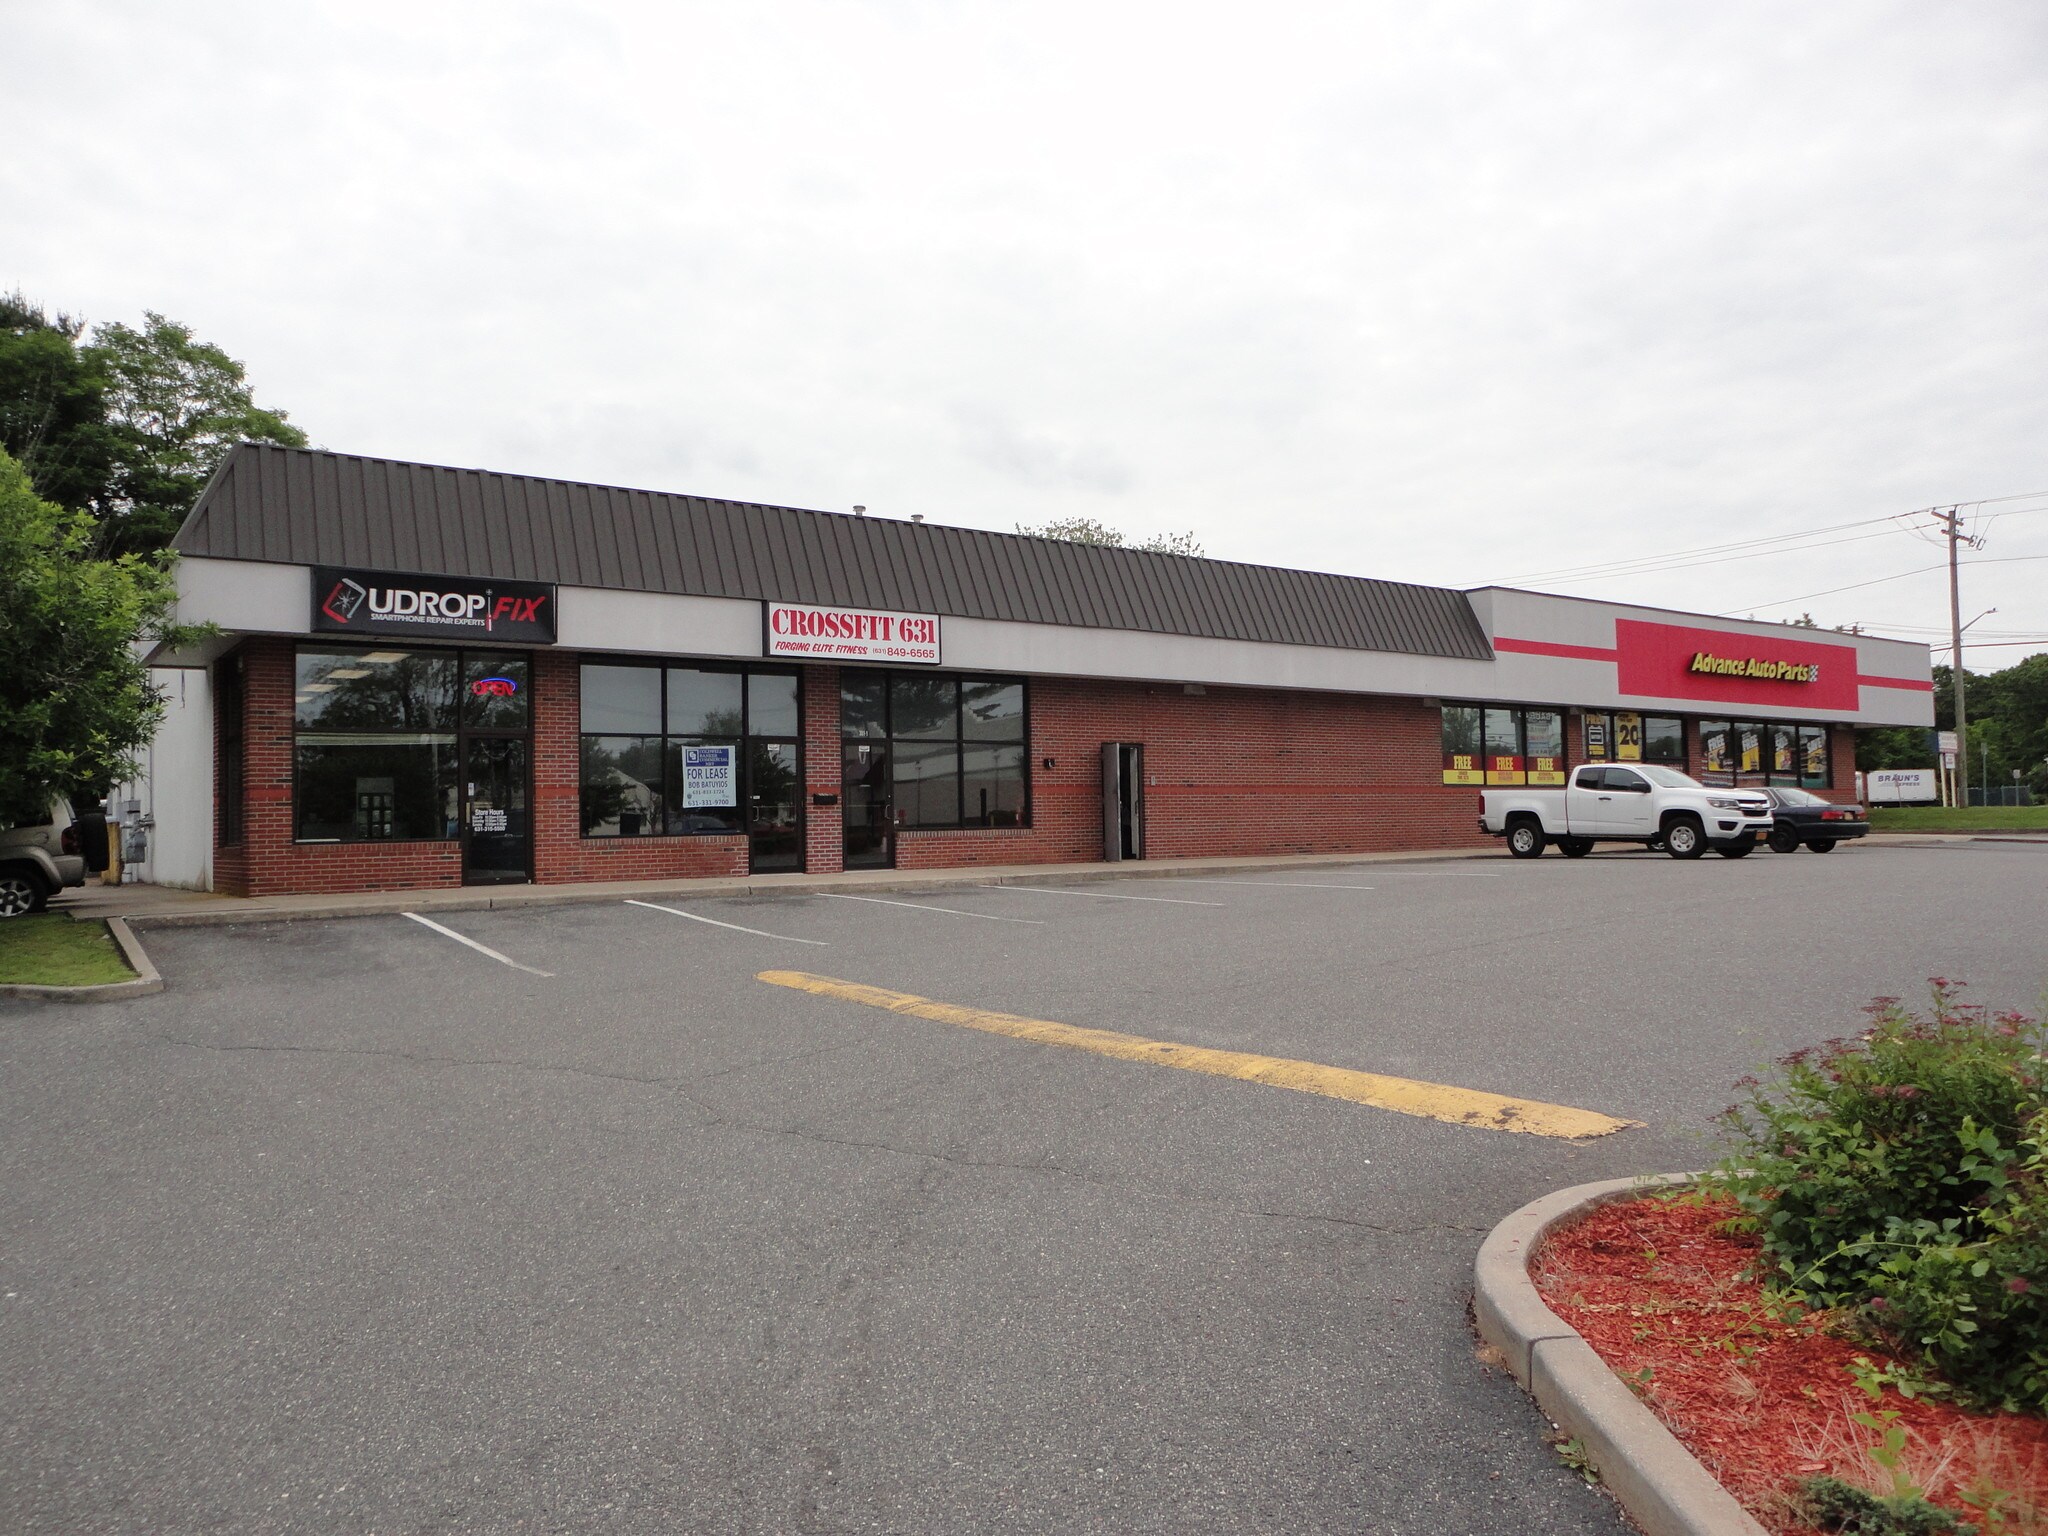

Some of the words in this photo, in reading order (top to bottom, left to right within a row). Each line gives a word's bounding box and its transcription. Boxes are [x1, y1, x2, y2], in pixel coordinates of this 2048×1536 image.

[491, 595, 546, 623] FIX
[370, 613, 426, 624] SMARTPHONE
[426, 615, 454, 625] REPAIR
[454, 617, 486, 627] EXPERTS
[772, 609, 894, 641] CROSSFIT
[899, 617, 936, 644] 631
[775, 641, 811, 652] FORGING
[812, 643, 835, 653] ELITE
[835, 644, 868, 655] FITNESS
[1691, 652, 1745, 676] Advance
[1745, 657, 1777, 679] Auto
[1777, 660, 1809, 682] Parts
[471, 680, 514, 697] OPEN
[1453, 755, 1472, 769] FREE
[1496, 756, 1513, 771] FREE
[1537, 757, 1554, 771] FREE
[687, 768, 703, 780] FOR
[705, 767, 728, 779] LEASE
[1878, 774, 1920, 782] BRAUN'S
[489, 808, 504, 816] Hours
